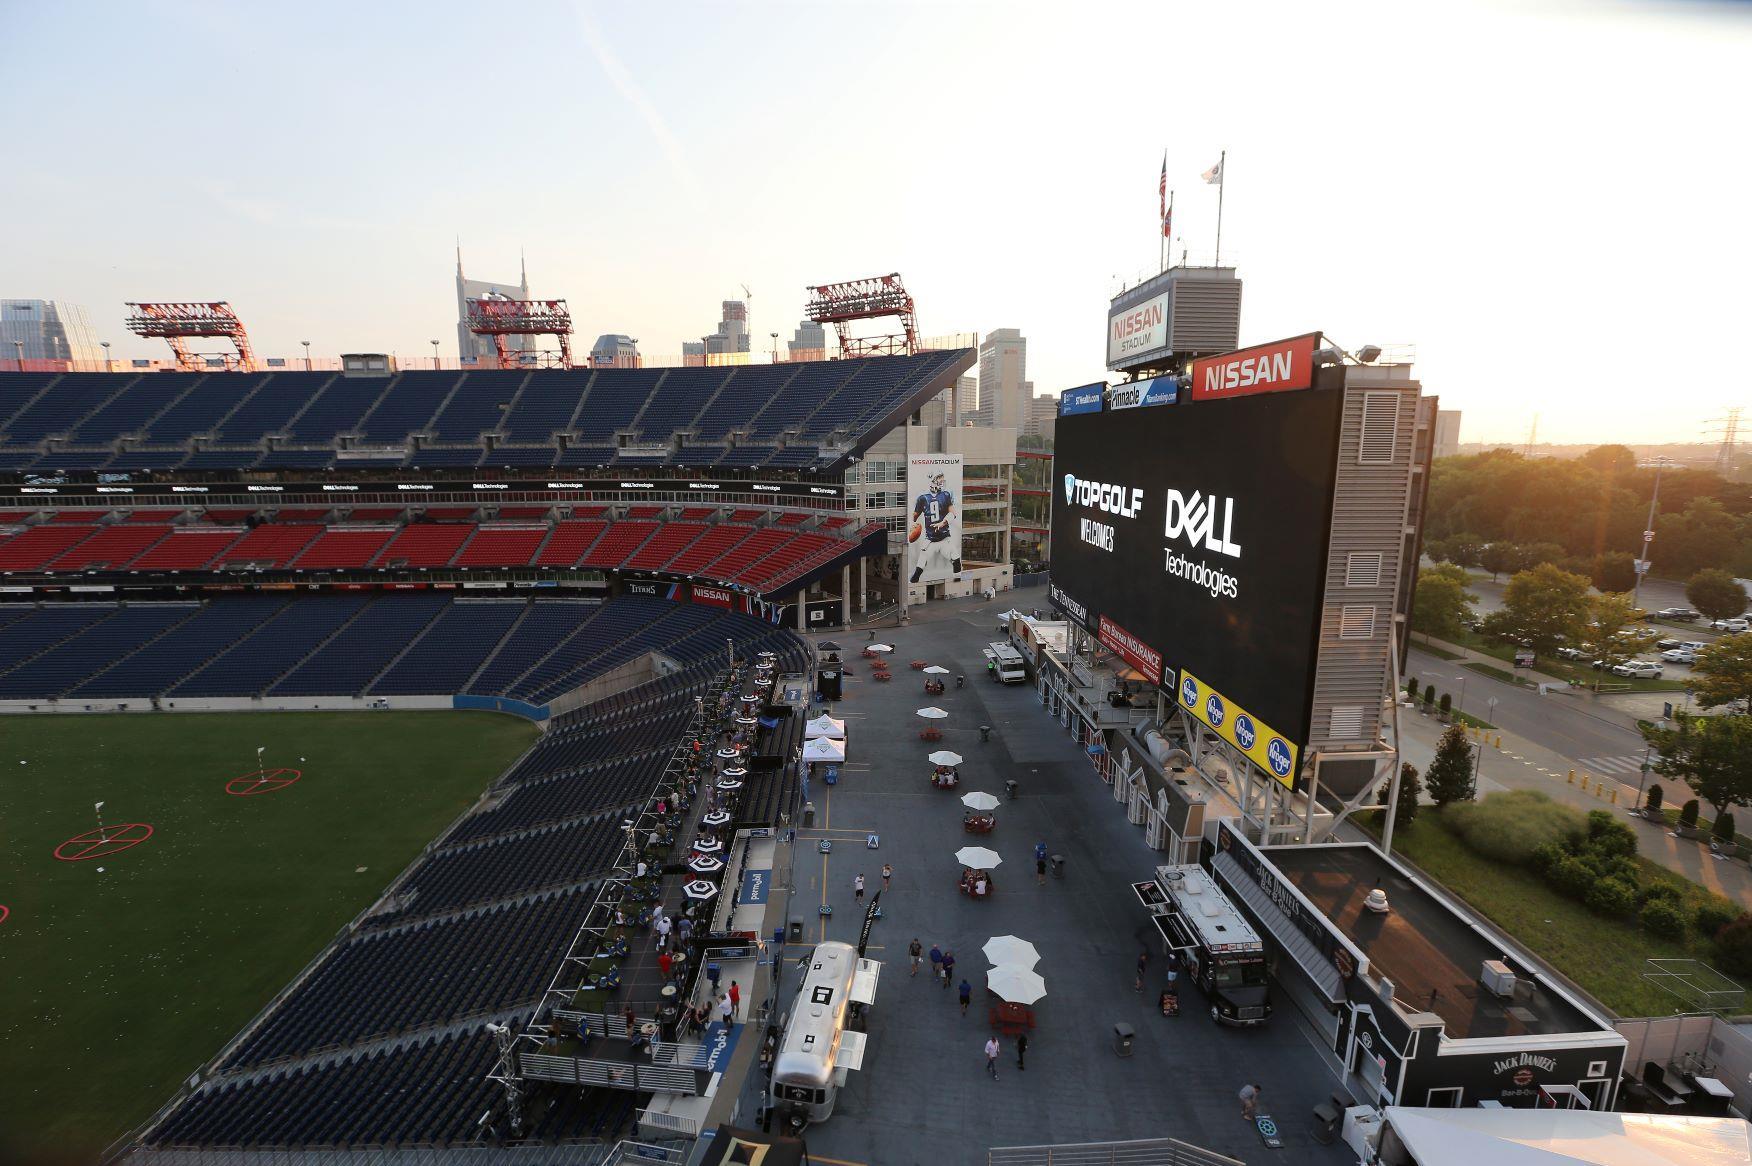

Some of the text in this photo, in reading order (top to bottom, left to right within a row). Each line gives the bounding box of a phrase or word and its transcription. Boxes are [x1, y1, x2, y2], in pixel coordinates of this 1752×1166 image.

[1114, 303, 1162, 340] NISSAN
[1122, 332, 1152, 352] STADIUM
[1205, 351, 1292, 391] NISSAN
[1111, 386, 1140, 408] Pinnacle
[930, 501, 940, 522] 9
[1075, 479, 1144, 519] TOPGOLF
[1080, 517, 1115, 553] WELCOMES
[1164, 489, 1242, 558] DELL
[1164, 548, 1238, 598] Technologies
[693, 587, 730, 602] NISSAN
[1060, 589, 1087, 620] TENNESSEAN
[1100, 618, 1111, 634] Farm
[1127, 636, 1160, 670] INSURANCE
[1183, 680, 1197, 704] Kroger
[1207, 698, 1224, 723] Kroger
[1236, 718, 1254, 746] Kroger
[1269, 742, 1291, 772] Kroger
[750, 873, 762, 901] permobil
[1256, 863, 1272, 888] JACK
[1493, 1056, 1518, 1075] JACK
